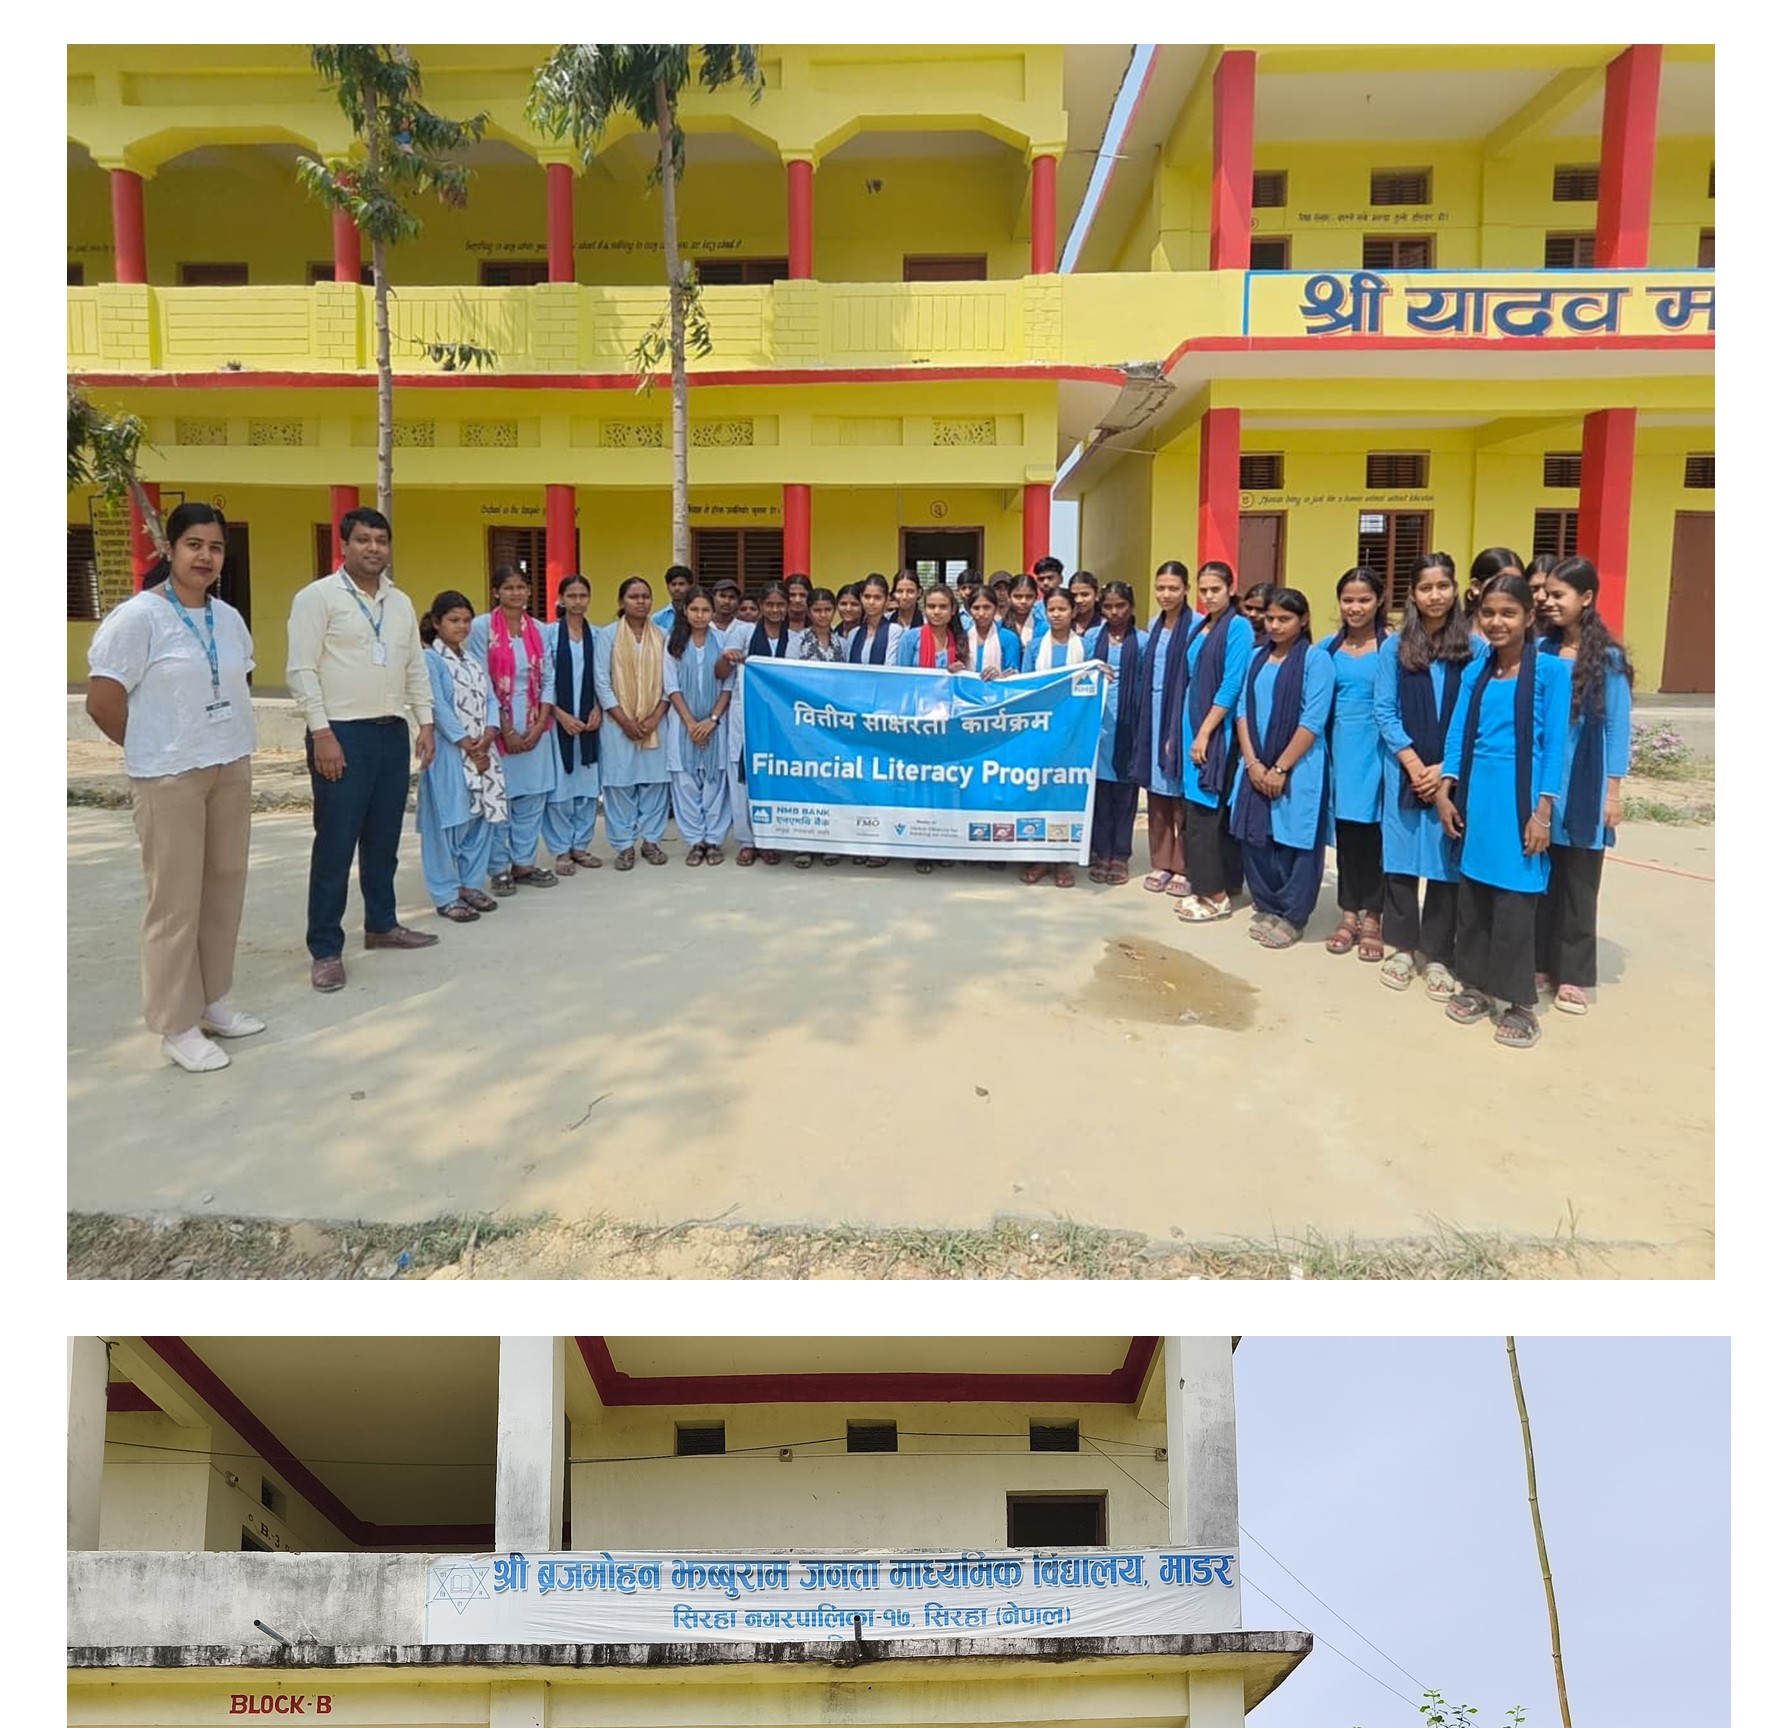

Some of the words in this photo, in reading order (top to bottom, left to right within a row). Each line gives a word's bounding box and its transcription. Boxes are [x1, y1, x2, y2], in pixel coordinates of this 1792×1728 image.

[1299, 271, 1392, 335] श्री
[1405, 286, 1631, 336] यादव
[794, 701, 855, 729] वित्तीय
[862, 711, 949, 735] साक्षरता
[961, 707, 1052, 733] कार्यक्रम
[752, 752, 863, 780] Financial
[872, 757, 973, 788] Literacy
[982, 760, 1090, 791] Program
[493, 1553, 528, 1592] श्री
[537, 1553, 662, 1595] ब्रजमोहन
[671, 1559, 791, 1599] झब्बुराम
[799, 1558, 880, 1591] जनता
[889, 1552, 1024, 1589] माध्यमिक
[1032, 1553, 1151, 1588] विद्यालय,
[1159, 1554, 1234, 1588] माडर
[673, 1603, 737, 1629] सिरहा
[924, 1602, 987, 1628] सिरहा
[995, 1601, 1071, 1626] (नेपाल)
